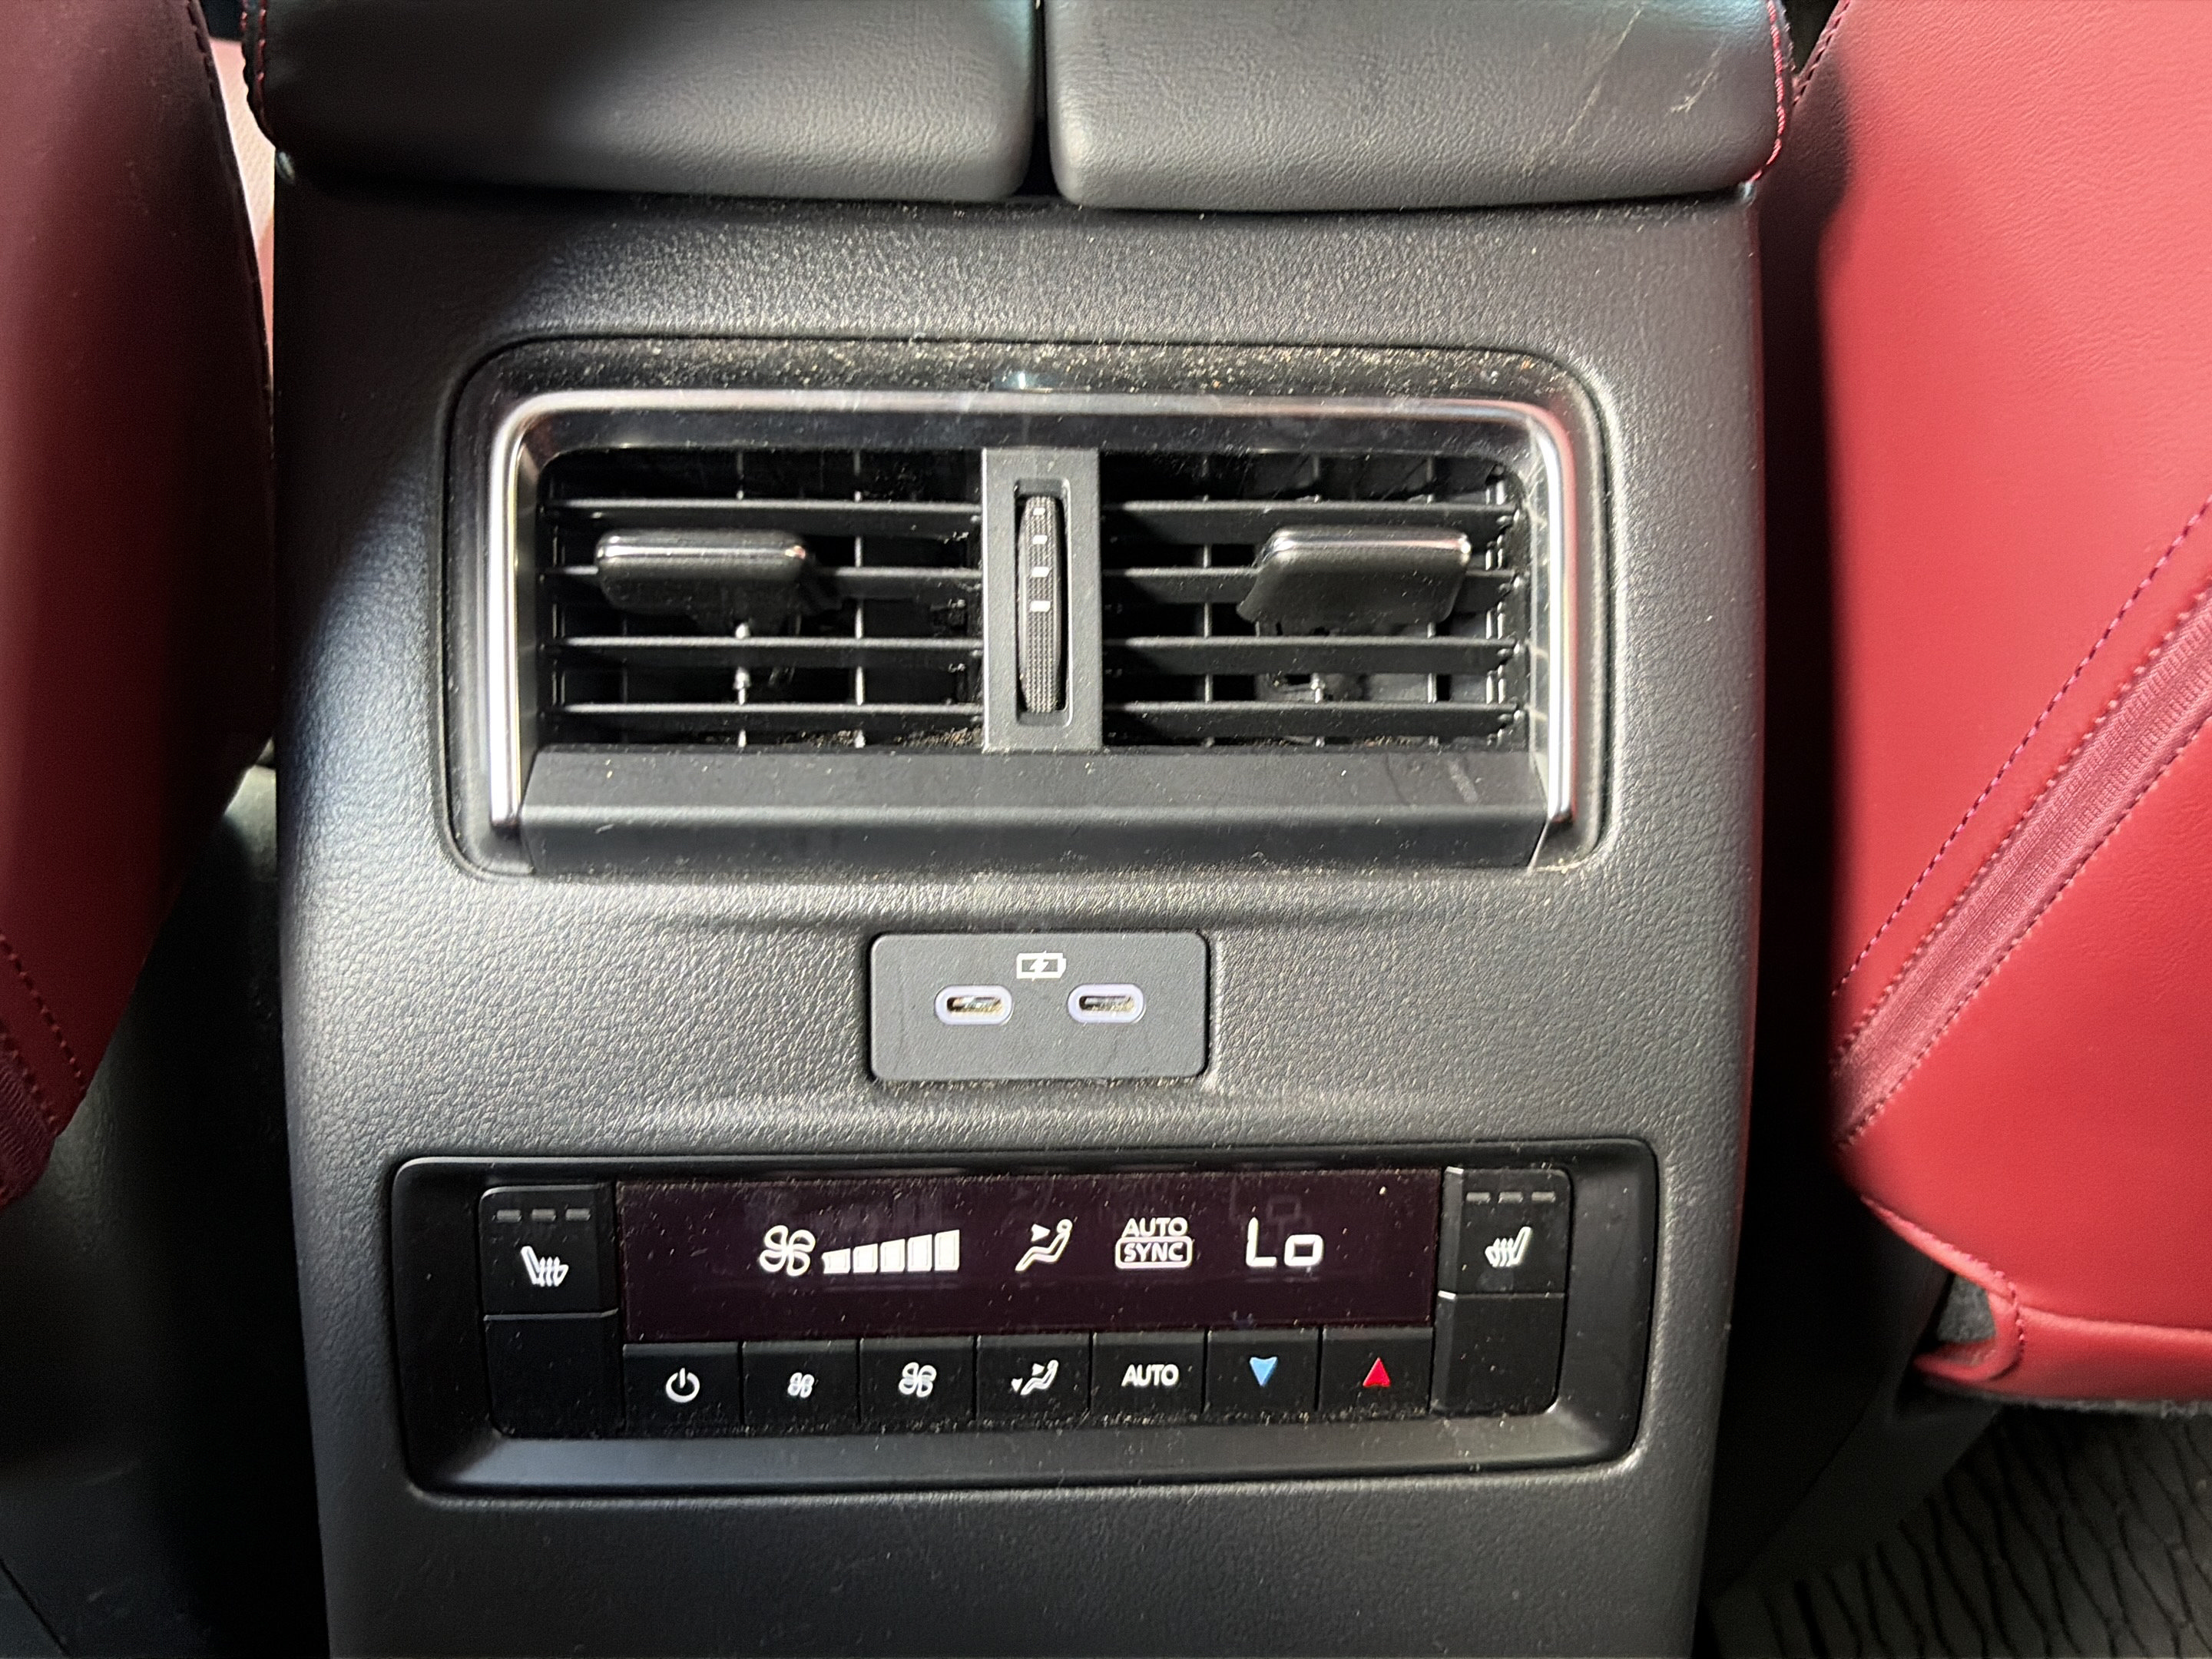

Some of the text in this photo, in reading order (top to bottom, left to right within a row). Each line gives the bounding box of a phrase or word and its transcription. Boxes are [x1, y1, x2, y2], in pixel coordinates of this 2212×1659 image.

[1121, 1217, 1188, 1237] AUTO
[1124, 1242, 1184, 1262] SYNC
[1246, 1217, 1324, 1267] Lo
[1121, 1364, 1179, 1386] AUTO
